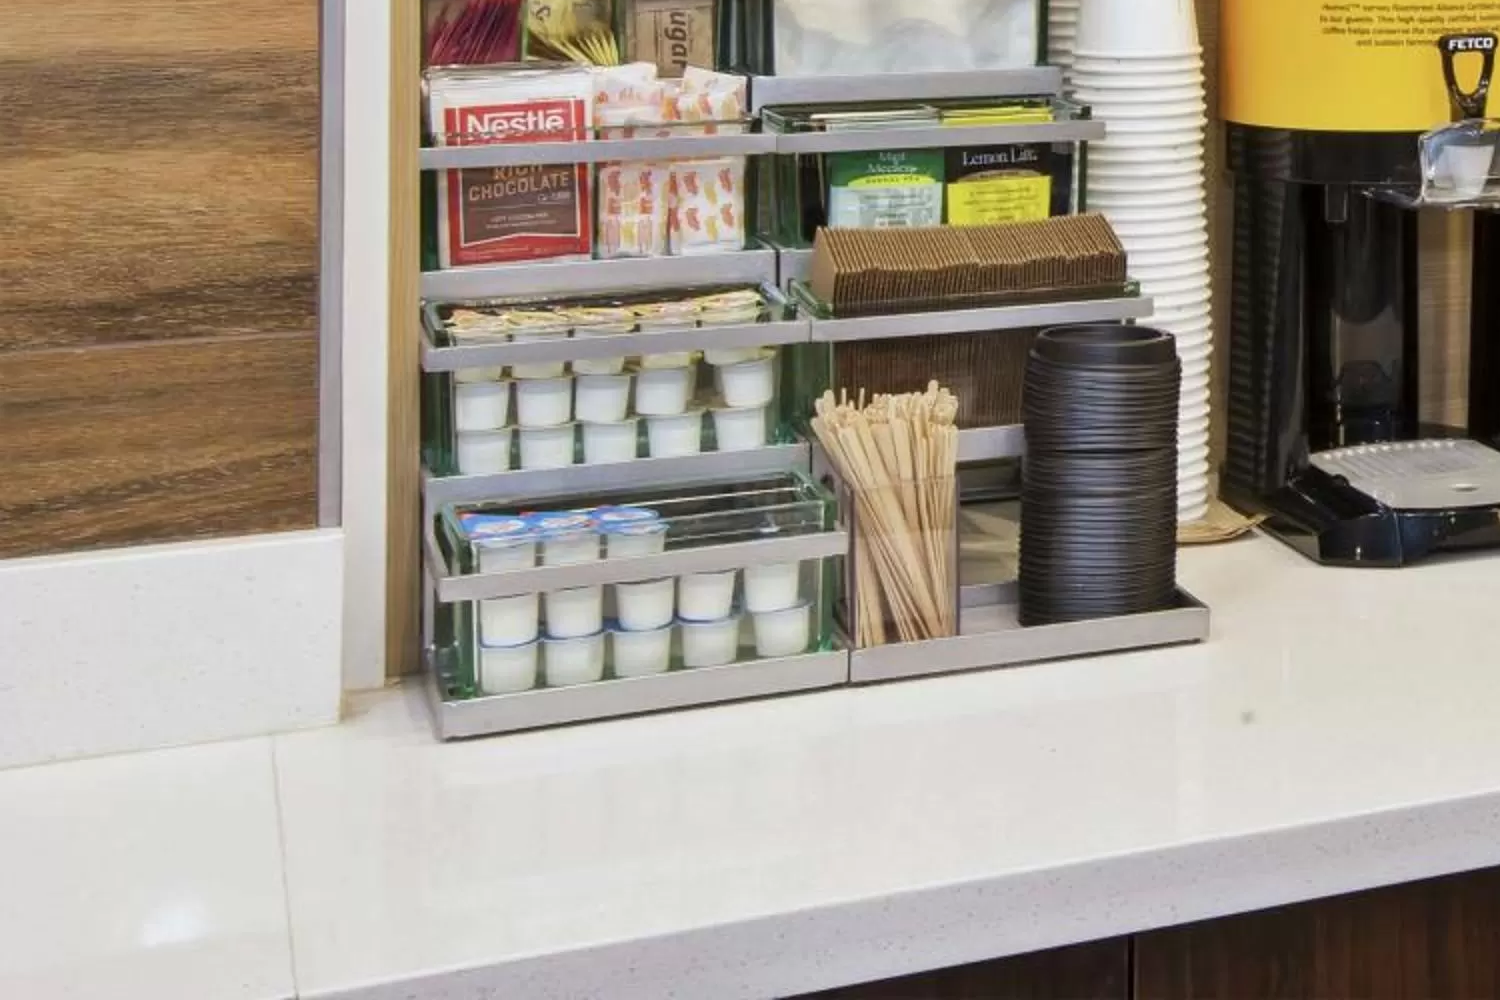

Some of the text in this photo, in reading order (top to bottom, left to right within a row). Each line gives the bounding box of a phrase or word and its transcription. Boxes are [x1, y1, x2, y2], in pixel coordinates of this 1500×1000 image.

[664, 11, 689, 69] ugar
[1448, 36, 1495, 51] FETCO
[468, 171, 570, 202] CHOCOLATE
